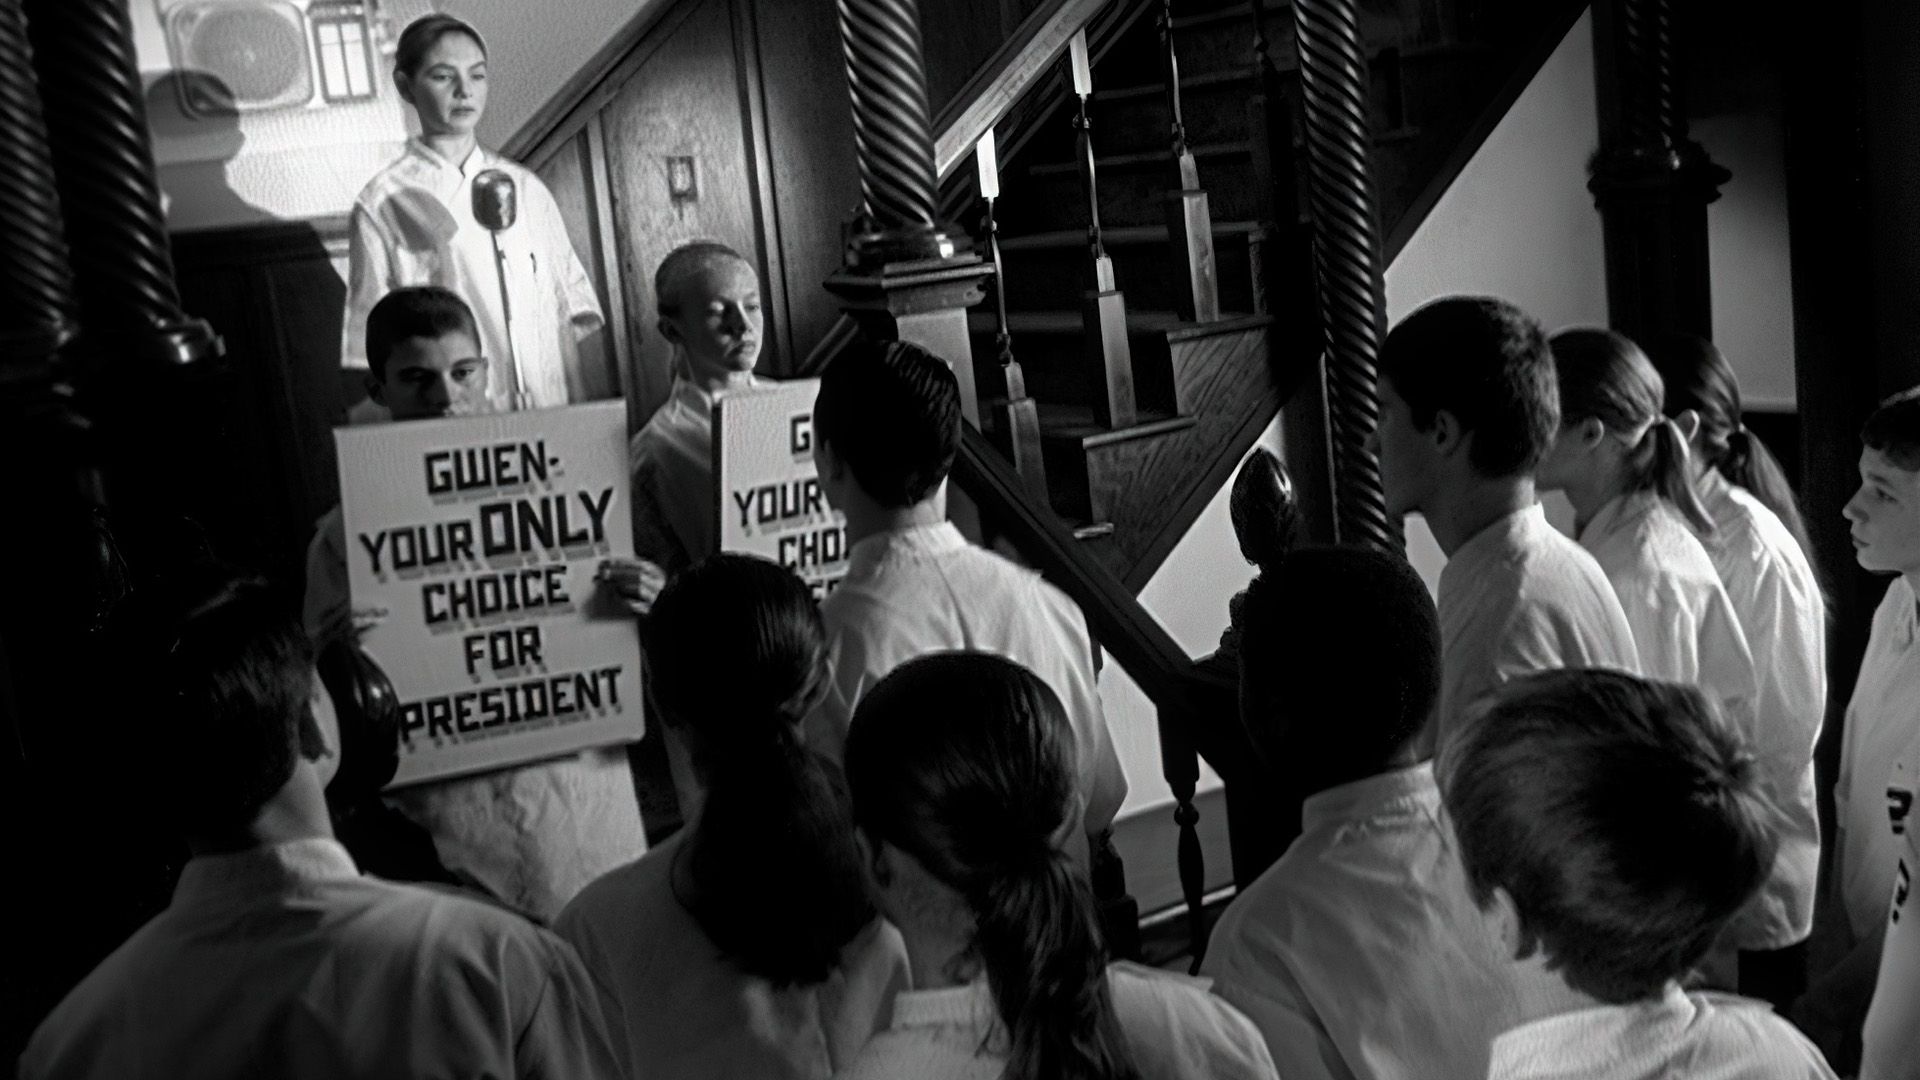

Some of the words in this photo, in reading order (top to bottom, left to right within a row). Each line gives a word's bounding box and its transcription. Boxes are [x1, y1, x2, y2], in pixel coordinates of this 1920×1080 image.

[791, 414, 811, 455] G
[734, 477, 823, 528] YOUR
[359, 519, 475, 574] YOUR
[480, 486, 613, 557] ONLY
[779, 527, 850, 572] CHO
[422, 565, 571, 626] CHOICE
[464, 625, 543, 675] FOR
[399, 666, 623, 744] PRESIDENT
